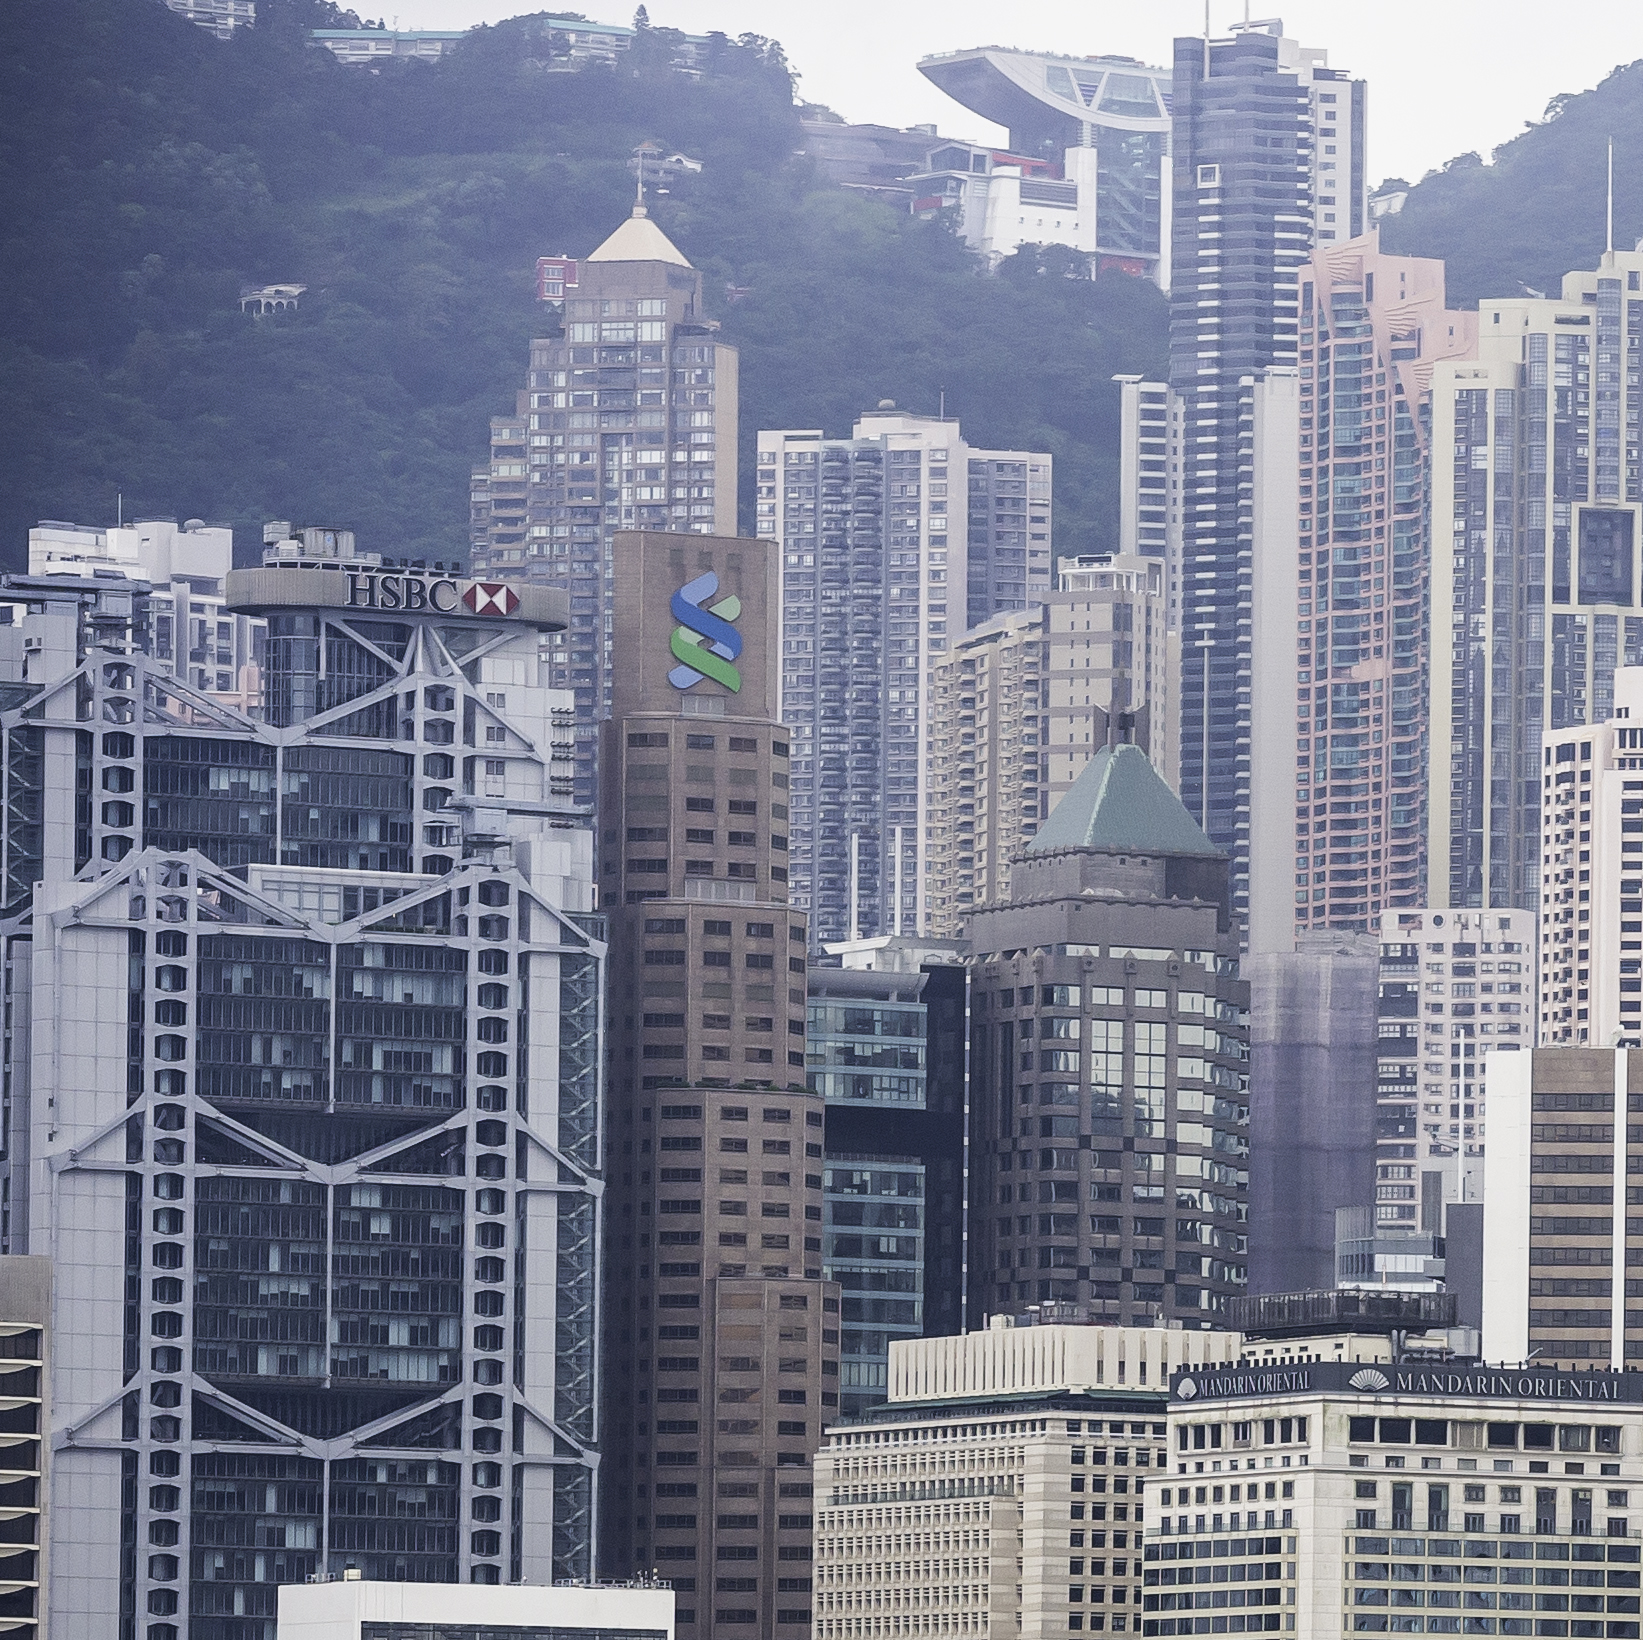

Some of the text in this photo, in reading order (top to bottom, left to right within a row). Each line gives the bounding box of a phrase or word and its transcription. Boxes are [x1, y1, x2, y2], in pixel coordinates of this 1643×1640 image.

[344, 571, 457, 613] HSBC
[1200, 1370, 1311, 1397] MANDARIN ORIENTAL
[1396, 1372, 1624, 1399] MANDARIN ORIENTAL
